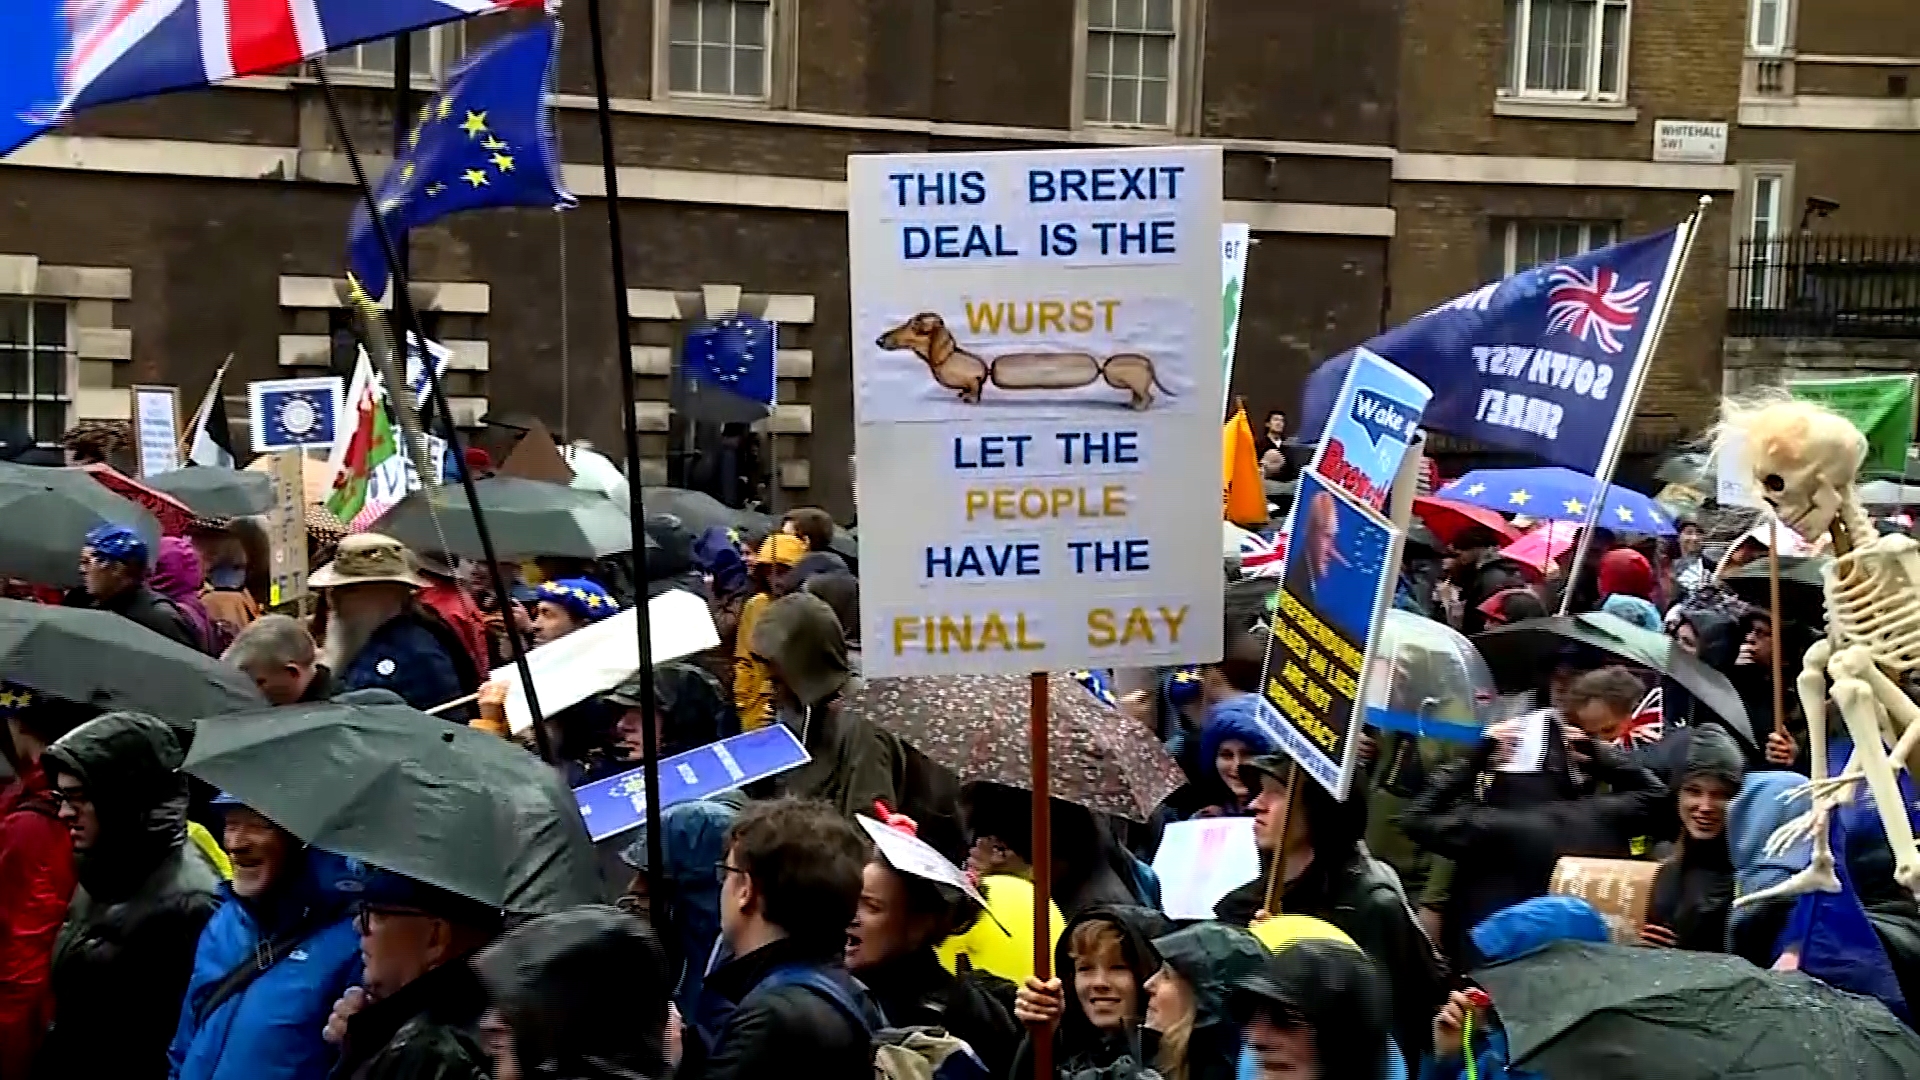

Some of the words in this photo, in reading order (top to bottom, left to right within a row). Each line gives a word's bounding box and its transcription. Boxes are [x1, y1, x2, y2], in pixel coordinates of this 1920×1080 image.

[1661, 125, 1722, 138] WHITEHALL
[1661, 138, 1683, 150] SW1
[890, 170, 986, 206] THIS
[1028, 166, 1185, 203] BREXIT
[903, 224, 1018, 260] DEAL
[1040, 223, 1078, 256] IS
[1092, 220, 1176, 255] THE
[965, 299, 1121, 335] WURST
[1356, 394, 1404, 432] Wake
[954, 435, 1032, 469] LET
[1055, 431, 1139, 464] THE
[965, 485, 1128, 521] PEOPLE
[926, 544, 1040, 578] HAVE
[1067, 539, 1150, 573] THE
[893, 611, 1045, 656] FINAL
[1087, 604, 1189, 648] SAY
[1268, 677, 1341, 752] DEMOCRACY
